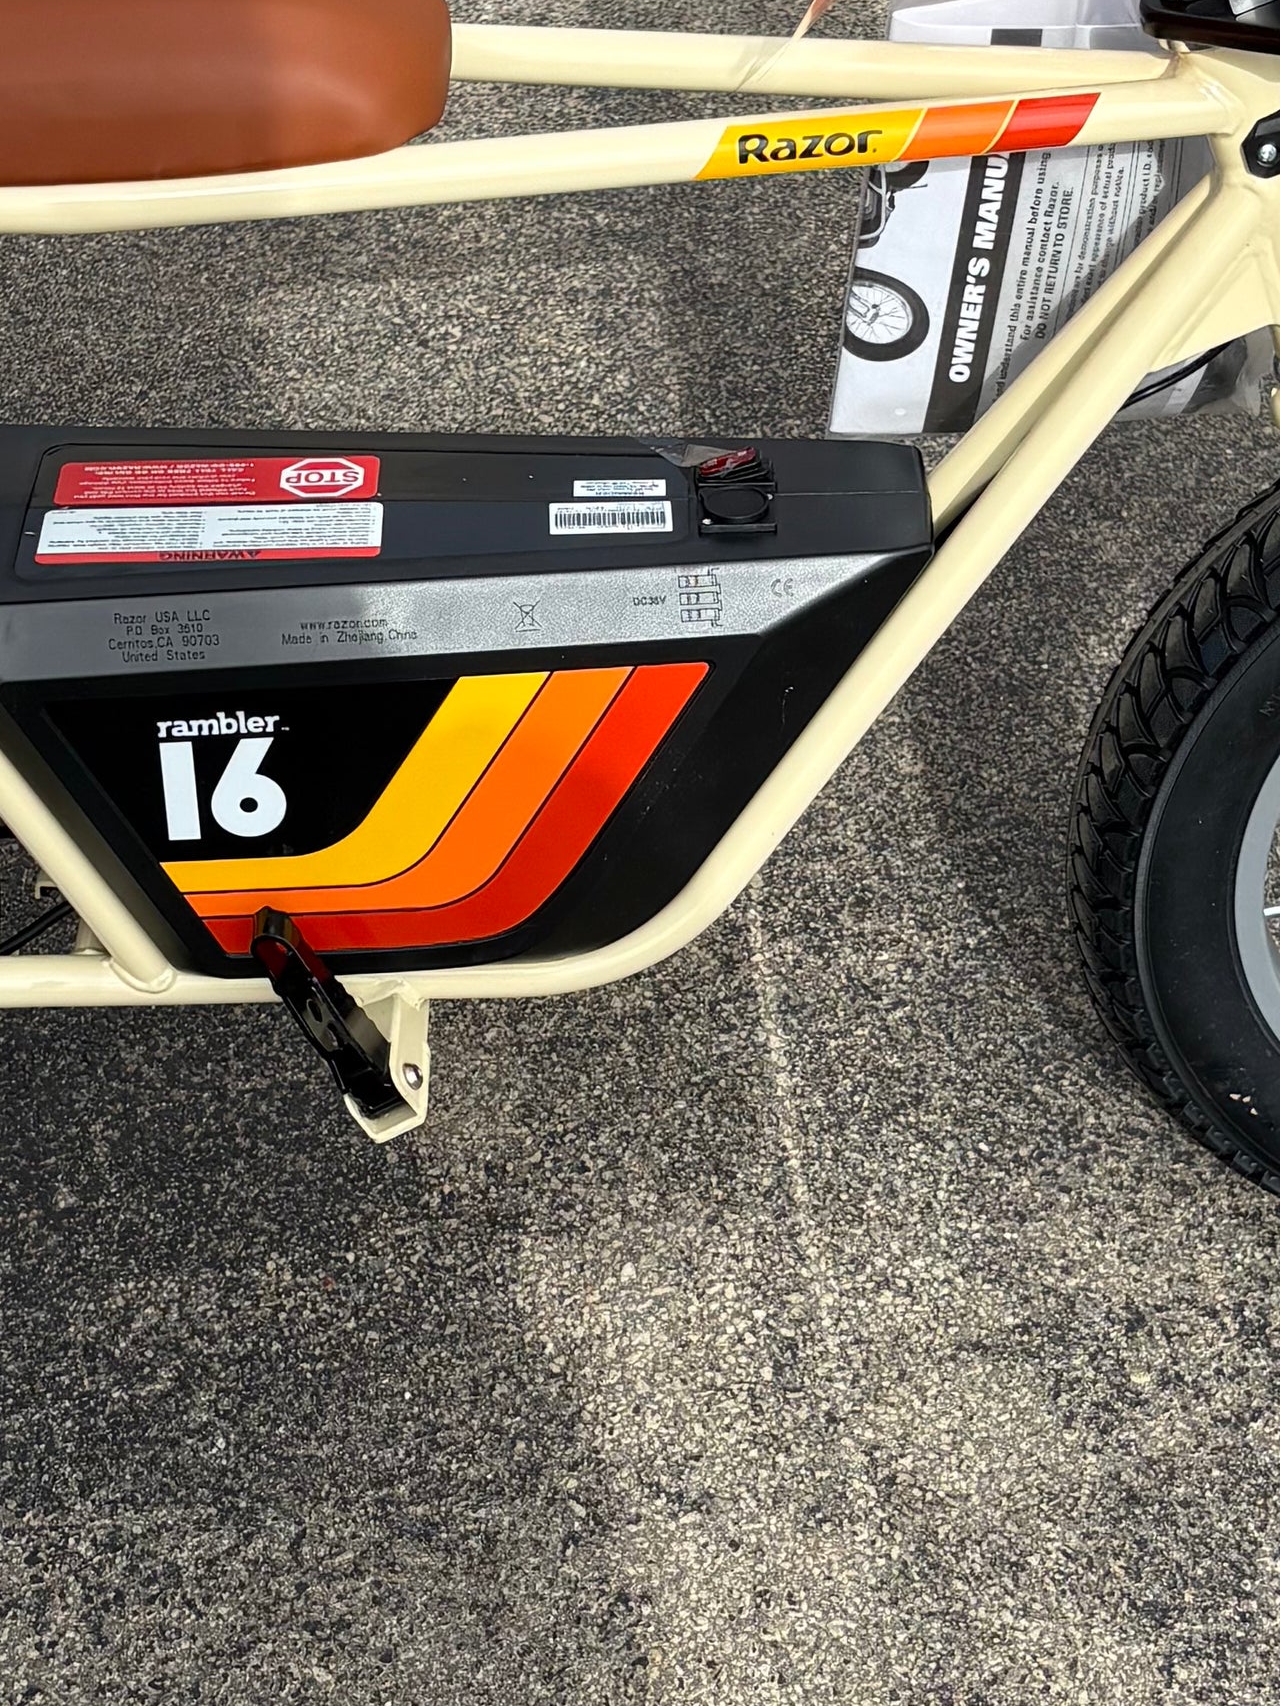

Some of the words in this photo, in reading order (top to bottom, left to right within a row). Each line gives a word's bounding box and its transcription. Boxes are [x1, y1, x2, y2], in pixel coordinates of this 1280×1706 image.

[737, 129, 883, 165] Razor
[1037, 151, 1052, 185] using
[1028, 188, 1043, 225] before
[1043, 181, 1060, 218] Razor.
[1056, 186, 1074, 230] STORE.
[1022, 227, 1036, 267] manual
[1037, 221, 1053, 264] contact
[1053, 233, 1065, 248] TO
[948, 256, 991, 383] OWNER'S
[972, 154, 1011, 251] MANU
[1044, 250, 1062, 294] RETURN
[1015, 269, 1028, 300] entire
[1026, 266, 1044, 321] assistance
[1010, 303, 1021, 322] this
[1038, 297, 1052, 320] NOT
[1020, 324, 1032, 341] For
[1035, 322, 1047, 340] DO
[999, 324, 1017, 380] understand
[284, 469, 360, 485] STOP
[159, 550, 251, 561] WARNING
[113, 612, 147, 625] Razor
[155, 610, 180, 623] USA
[187, 609, 211, 622] LLC
[151, 624, 171, 635] Box
[299, 618, 388, 631] www.razor.com
[181, 634, 220, 647] 90703
[281, 633, 313, 645] Made
[319, 632, 329, 644] in
[122, 651, 158, 663] United
[166, 649, 206, 661] States
[156, 710, 280, 738] rambler
[159, 737, 287, 841] 16
